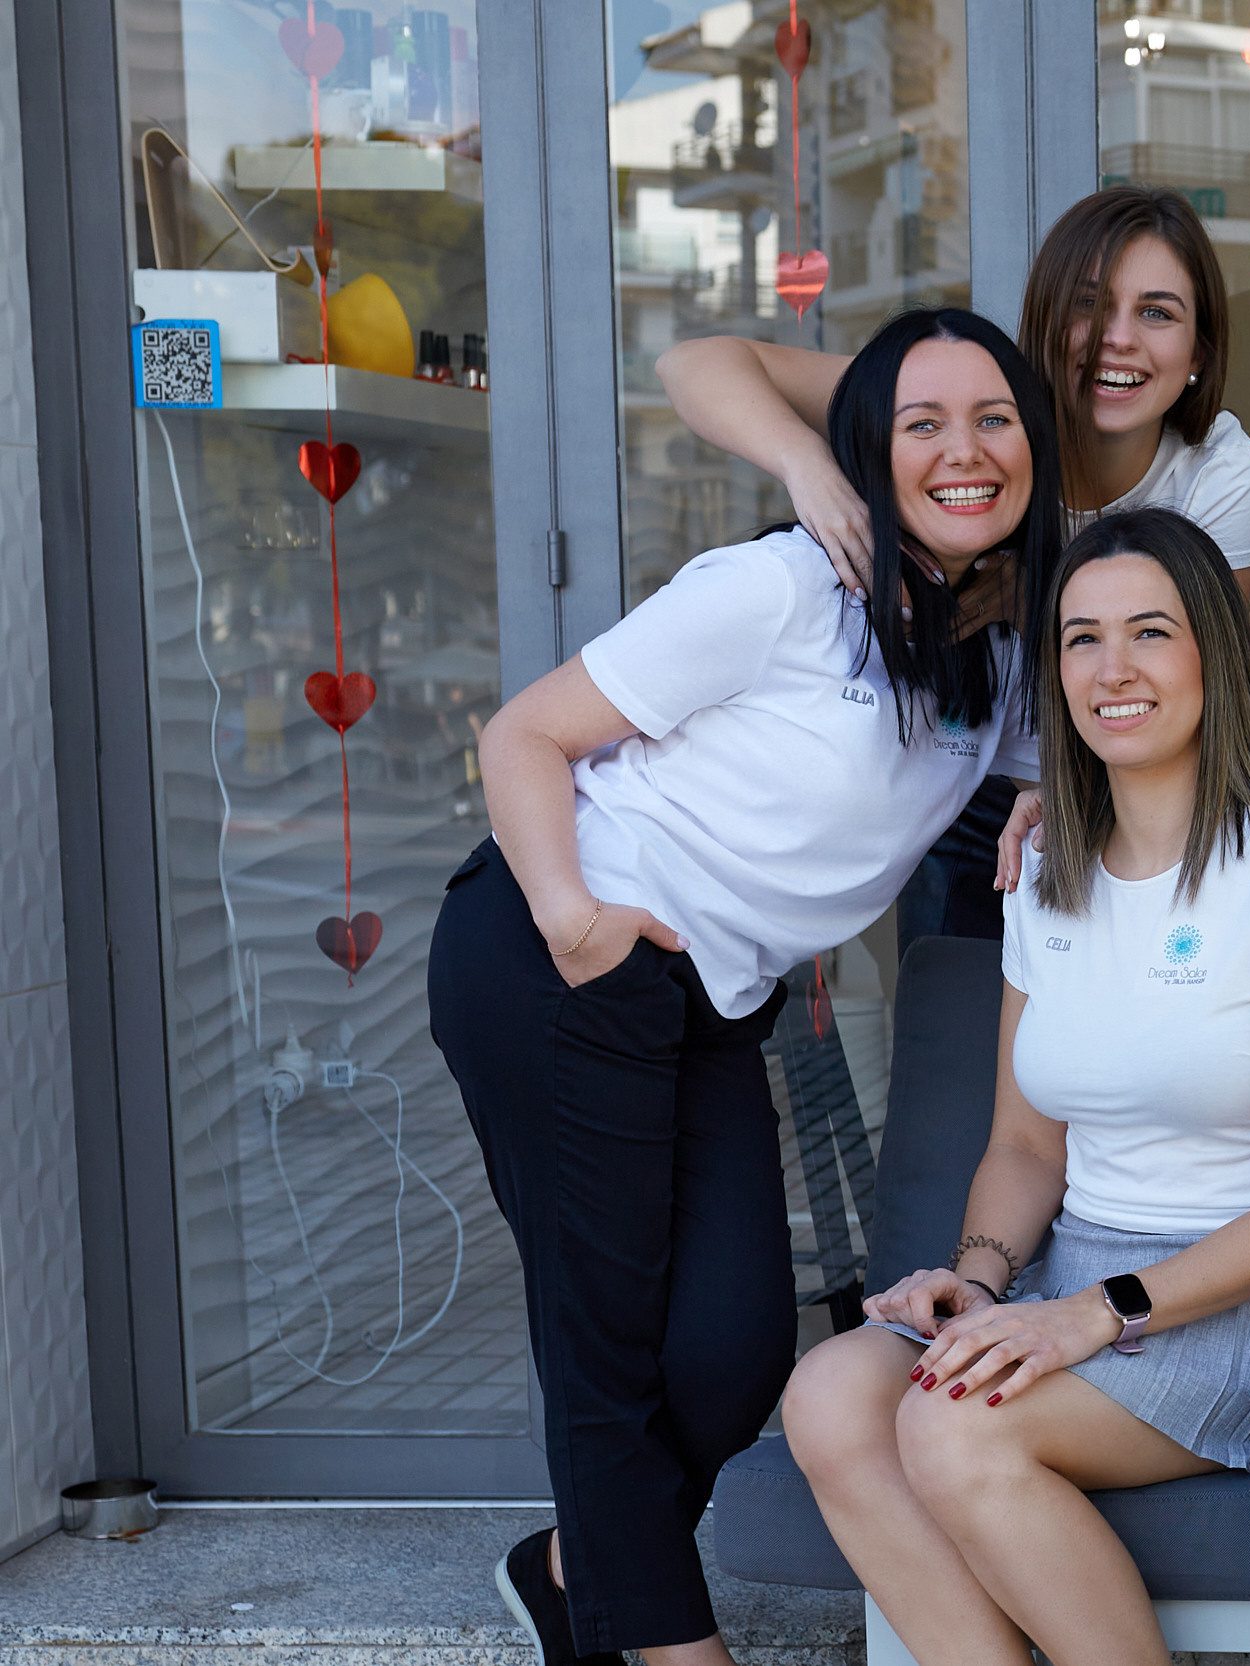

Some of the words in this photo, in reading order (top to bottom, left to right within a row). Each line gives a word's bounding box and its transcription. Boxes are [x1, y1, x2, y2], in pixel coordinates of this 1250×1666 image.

[841, 686, 875, 707] LILIA
[933, 737, 960, 750] Dream
[1045, 936, 1072, 952] CELIA
[1147, 967, 1178, 979] Dream
[1180, 966, 1208, 979] Salon
